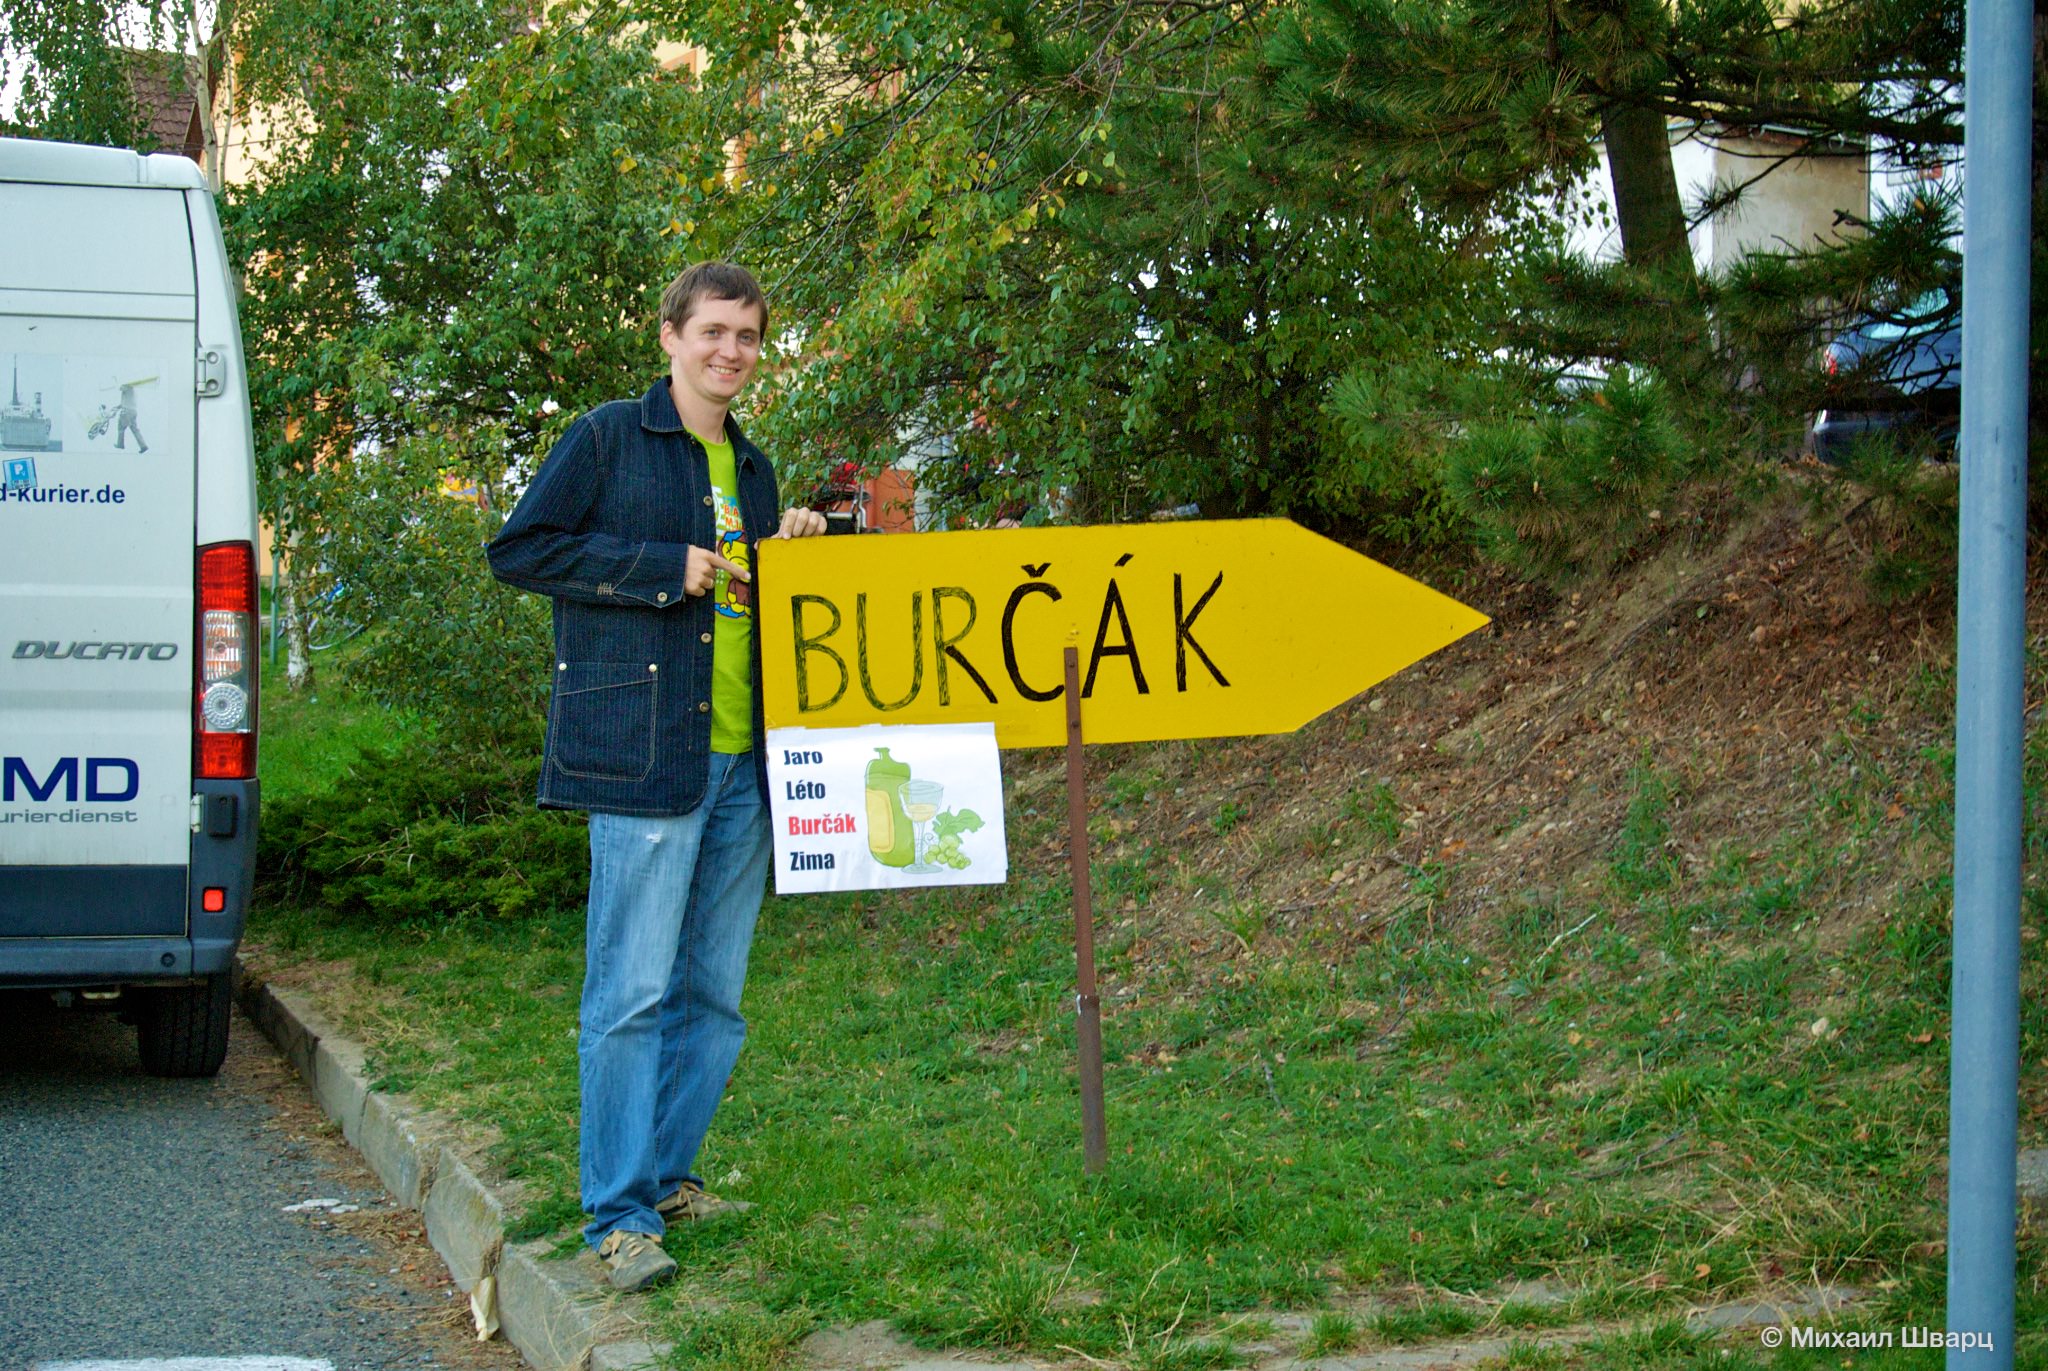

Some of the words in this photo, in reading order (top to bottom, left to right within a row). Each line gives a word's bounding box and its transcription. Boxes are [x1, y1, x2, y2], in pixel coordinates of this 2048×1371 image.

[790, 552, 1231, 714] BURČÁK
[12, 640, 178, 661] DUCATO
[783, 749, 824, 766] Jaro
[3, 757, 140, 802] MD
[786, 779, 826, 801] Léto
[0, 809, 138, 823] urierdienst
[788, 811, 857, 836] Burčák
[790, 851, 836, 872] Zima
